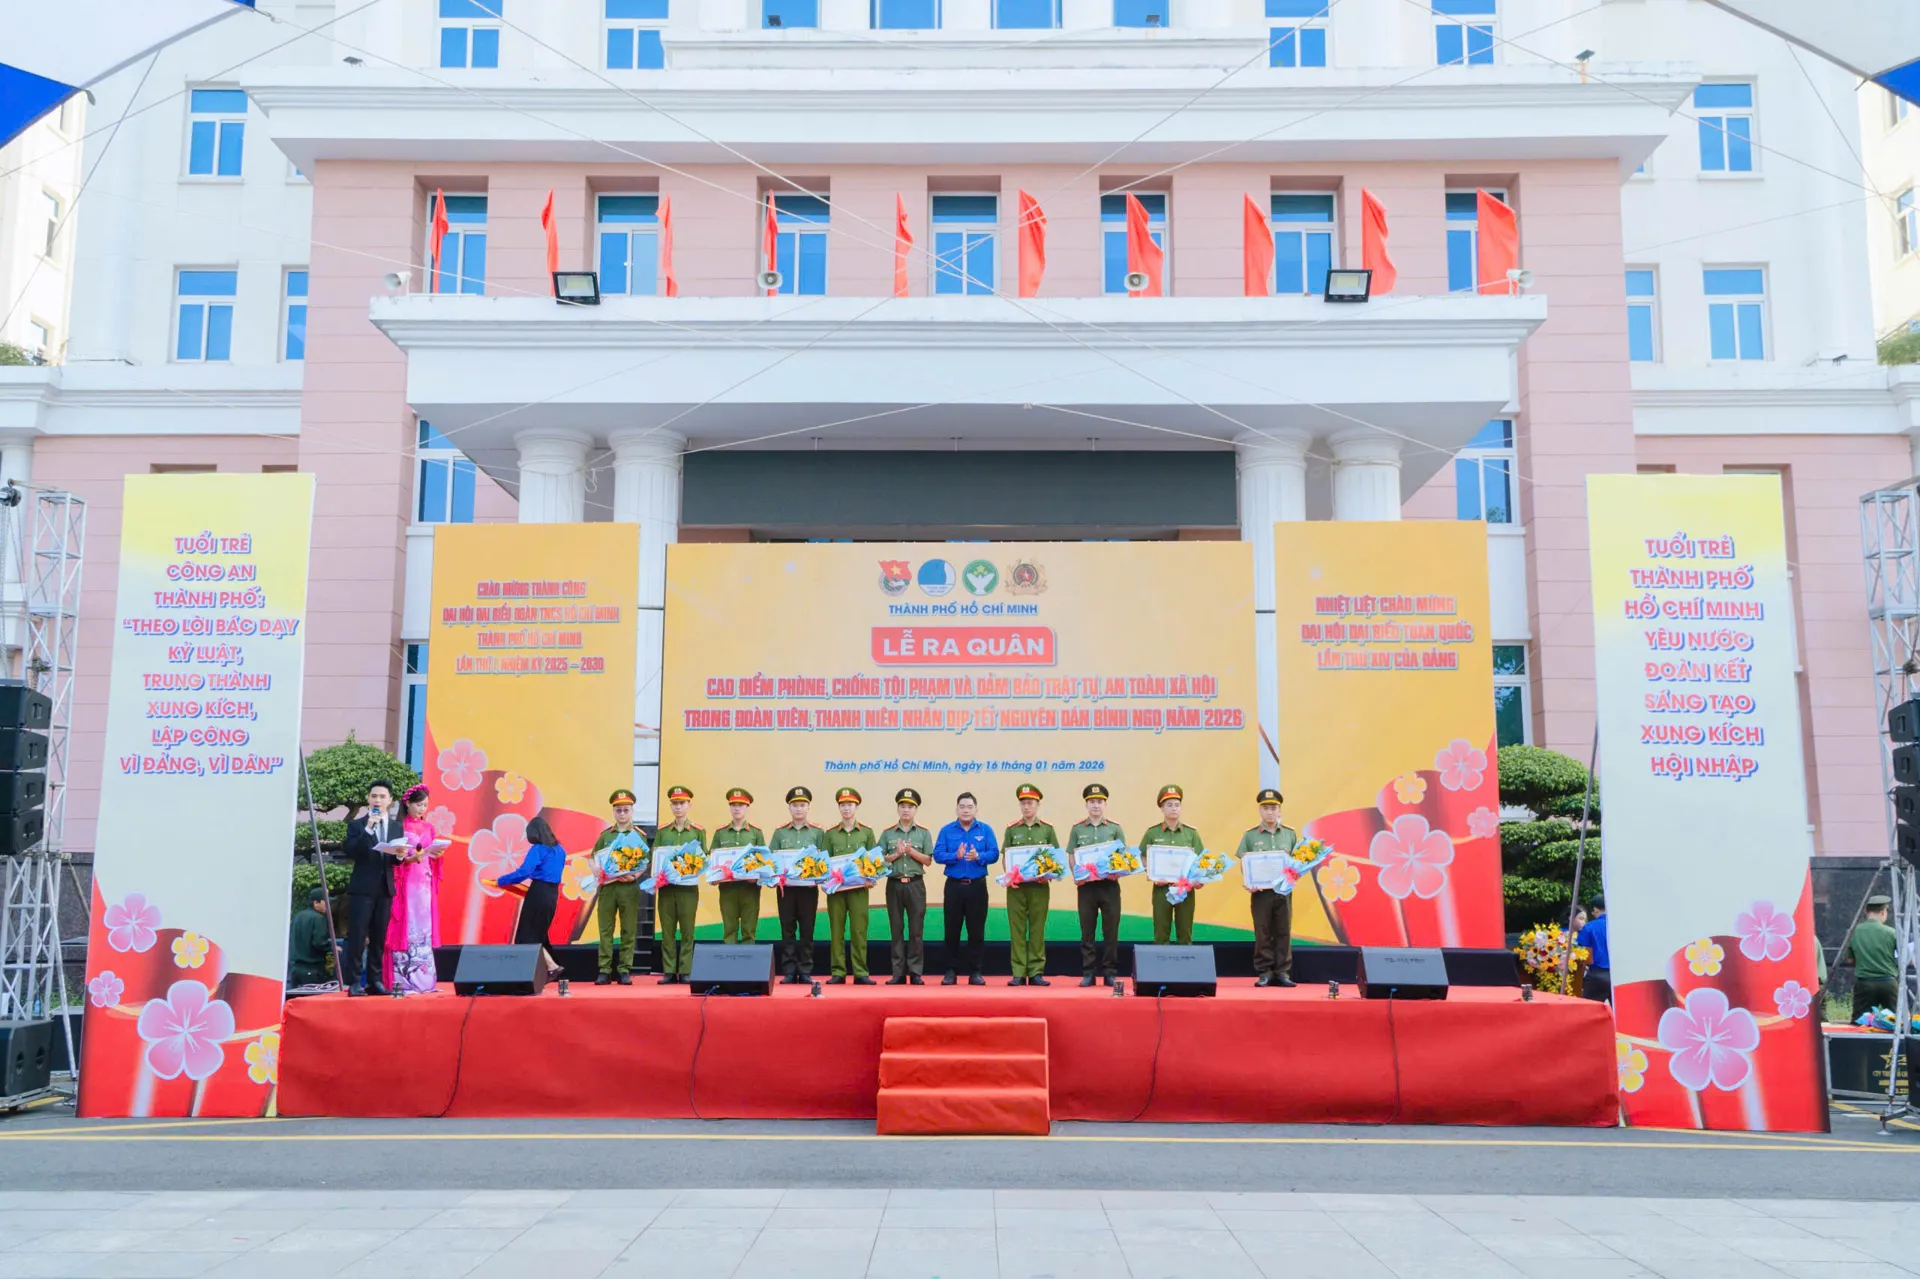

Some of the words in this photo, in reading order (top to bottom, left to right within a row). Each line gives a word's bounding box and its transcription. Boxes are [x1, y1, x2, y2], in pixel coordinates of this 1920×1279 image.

[175, 530, 217, 554] TUỔI
[220, 533, 251, 553] TRẺ
[1645, 532, 1695, 557] TUỔI
[1697, 535, 1735, 558] TRẺ
[166, 562, 225, 580] CÔNG
[228, 564, 255, 580] AN
[1630, 566, 1703, 588] THÀNH
[1707, 564, 1754, 589] PHỐ
[154, 588, 217, 608] THÀNH
[220, 586, 265, 607] PHỐ:
[477, 579, 500, 598] CHÀO
[502, 579, 529, 598] MỪNG
[531, 579, 561, 597] THÀNH
[562, 579, 586, 597] CÔNG
[442, 607, 457, 627] ĐẠI
[459, 606, 474, 626] HỘI
[476, 607, 490, 627] ĐẠI
[492, 602, 512, 624] BIỂU
[514, 605, 538, 623] ĐOÀN
[539, 607, 562, 622] TNCS
[564, 604, 576, 622] HỒ
[578, 605, 594, 622] CHÍ
[595, 606, 619, 622] MINH
[889, 602, 928, 616] THÀNH
[932, 601, 958, 616] PHỐ
[961, 600, 978, 616] HỒ
[982, 603, 1004, 616] CHÍ
[1007, 605, 1038, 616] MINH
[1315, 594, 1351, 618] NHIỆT
[1354, 594, 1378, 618] LIỆT
[1380, 595, 1413, 614] CHÀO
[1416, 594, 1455, 614] MỪNG
[1625, 593, 1660, 619] HỒ
[1662, 596, 1703, 618] CHÍ
[1707, 601, 1764, 620] MINH
[182, 615, 213, 635] LỜI
[216, 616, 256, 635] BÁC
[259, 619, 299, 639] DẠY
[478, 630, 506, 648] THÀNH
[508, 628, 526, 648] PHỐ
[527, 630, 539, 648] HỒ
[541, 630, 556, 648] CHÍ
[558, 631, 582, 648] MINH
[1301, 624, 1323, 645] ĐẠI
[1324, 621, 1346, 644] HỘI
[1349, 624, 1369, 645] ĐẠI
[1372, 618, 1400, 642] BIỂU
[1403, 622, 1436, 642] TOÀN
[1439, 619, 1474, 644] QUỐC
[1644, 628, 1685, 650] YÊU
[1688, 628, 1754, 650] NƯỚC
[168, 642, 194, 662] KỶ
[197, 646, 244, 666] LUẬT,
[884, 629, 915, 656] LỄ
[923, 638, 960, 656] RA
[967, 634, 1045, 656] QUÂN
[456, 654, 472, 673] LẦN
[475, 655, 492, 673] THỨ
[501, 656, 529, 677] NHIỆM
[544, 657, 568, 671] 2025
[580, 657, 604, 673] 2030
[1317, 647, 1342, 669] LẦN
[1345, 647, 1369, 669] THỨ
[1371, 651, 1392, 668] XIV
[1394, 648, 1420, 669] CỦA
[1422, 648, 1457, 669] ĐẢNG
[1644, 659, 1710, 681] ĐOÀN
[1714, 657, 1752, 682] KẾT
[143, 674, 205, 689] TRUNG
[208, 671, 270, 689] THÀNH
[706, 677, 735, 699] CAO
[739, 672, 774, 699] ĐIỂM
[777, 676, 830, 700] PHÒNG,
[832, 672, 881, 698] CHỐNG
[884, 676, 906, 702] TỘI
[909, 678, 952, 702] PHẠM
[954, 676, 973, 698] VÀ
[977, 673, 1011, 698] ĐẢM
[1012, 673, 1042, 698] BẢO
[1044, 676, 1082, 702] TRẬT
[1105, 677, 1127, 697] AN
[1129, 675, 1165, 697] TOÀN
[1169, 675, 1190, 697] XÃ
[1192, 675, 1217, 702] HỘI
[146, 702, 202, 718] XUNG
[205, 698, 257, 720] KÍCH,
[1644, 690, 1707, 712] SÁNG
[1709, 695, 1756, 718] TẠO
[684, 709, 731, 729] TRONG
[735, 707, 773, 729] ĐOÀN
[776, 707, 813, 731] VIÊN,
[815, 709, 862, 729] THANH
[864, 707, 900, 729] NIÊN
[902, 708, 943, 729] NHÂN
[946, 709, 972, 734] DỊP
[973, 705, 999, 729] TẾT
[1000, 707, 1058, 729] NGUYÊN
[1060, 707, 1091, 729] ĐÁN
[1132, 709, 1163, 733] NGỌ
[1166, 705, 1201, 729] NĂM
[1204, 709, 1244, 729] 2026
[151, 726, 187, 748] LẬP
[190, 726, 249, 745] CÔNG
[1641, 725, 1705, 744] XUNG
[1708, 721, 1764, 745] KÍCH
[120, 754, 140, 773] VÌ
[143, 753, 204, 776] ĐẢNG,
[209, 754, 229, 773] VÌ
[825, 760, 856, 771] Thành
[859, 759, 882, 772] phố
[883, 758, 898, 771] Hồ
[902, 760, 921, 771] Chí
[923, 760, 951, 772] Minh,
[955, 760, 982, 773] ngày
[986, 761, 998, 771] 16
[1001, 760, 1032, 773] tháng
[1036, 761, 1047, 771] 01
[1052, 760, 1076, 771] năm
[1079, 760, 1105, 771] 2026
[1651, 753, 1694, 780] HỘI
[1696, 754, 1759, 782] NHẬP
